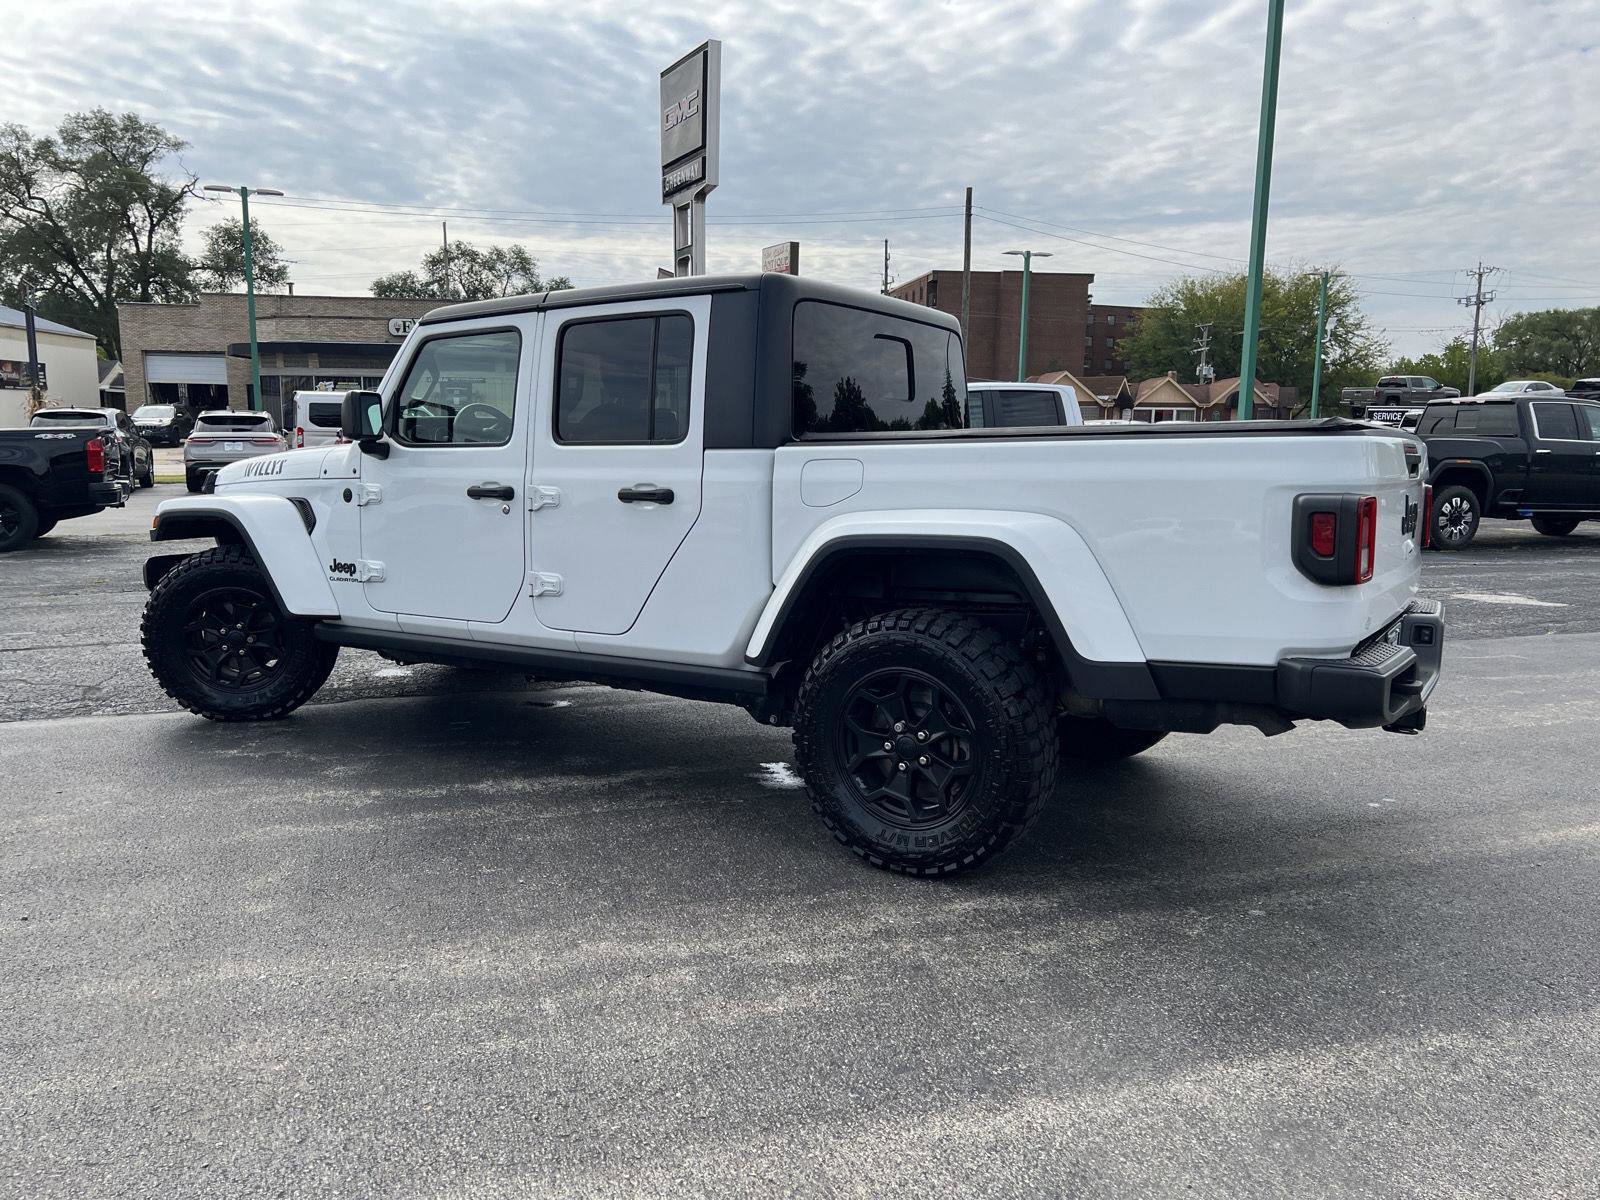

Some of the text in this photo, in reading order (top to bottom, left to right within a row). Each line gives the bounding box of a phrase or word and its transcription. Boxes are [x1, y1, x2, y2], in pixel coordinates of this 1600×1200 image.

[664, 90, 699, 132] GMC
[664, 161, 699, 192] GREENWAY
[1373, 412, 1402, 420] SERVICE
[244, 459, 287, 477] WILLYS
[329, 558, 356, 576] Jeep
